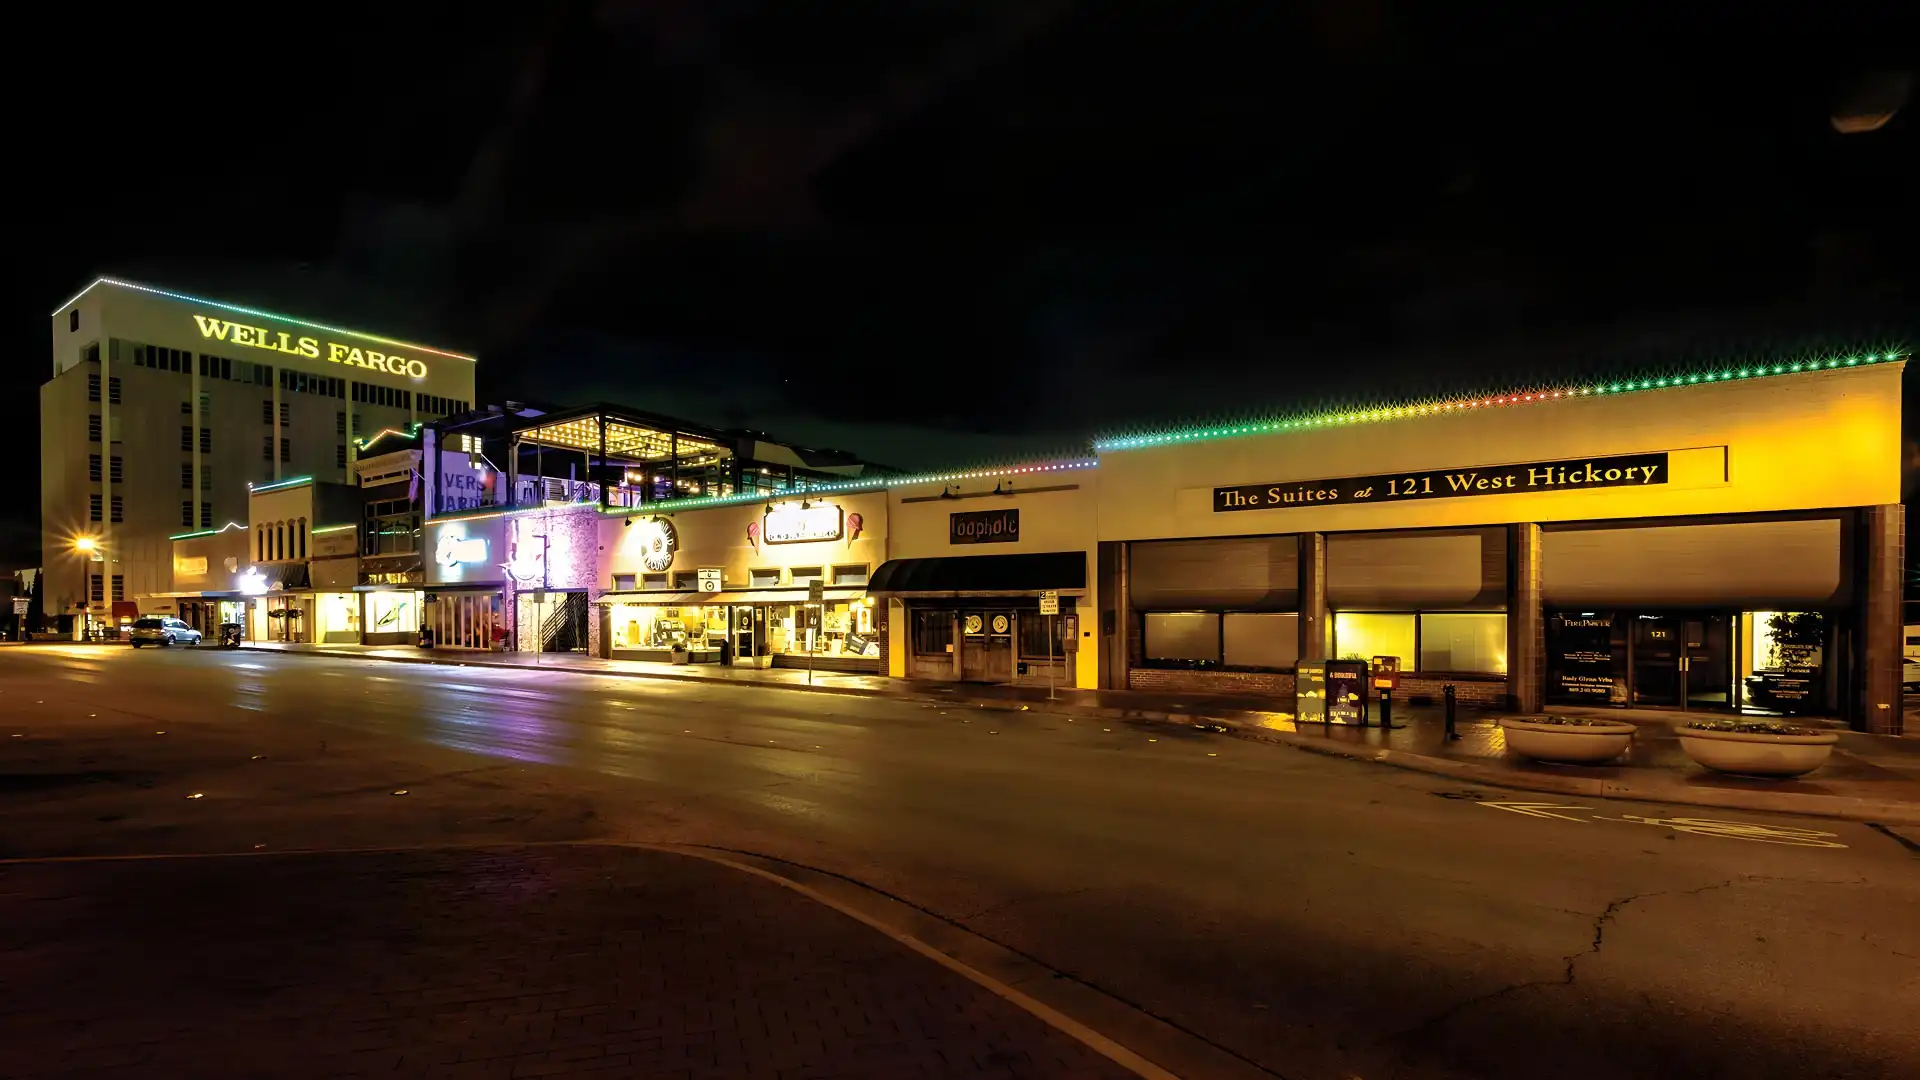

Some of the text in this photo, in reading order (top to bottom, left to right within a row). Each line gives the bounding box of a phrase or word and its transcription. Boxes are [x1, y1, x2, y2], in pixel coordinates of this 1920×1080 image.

[193, 315, 428, 379] WELLS FARGO
[1220, 463, 1659, 507] The Suites at 121 West Hickory
[1041, 591, 1046, 599] 2
